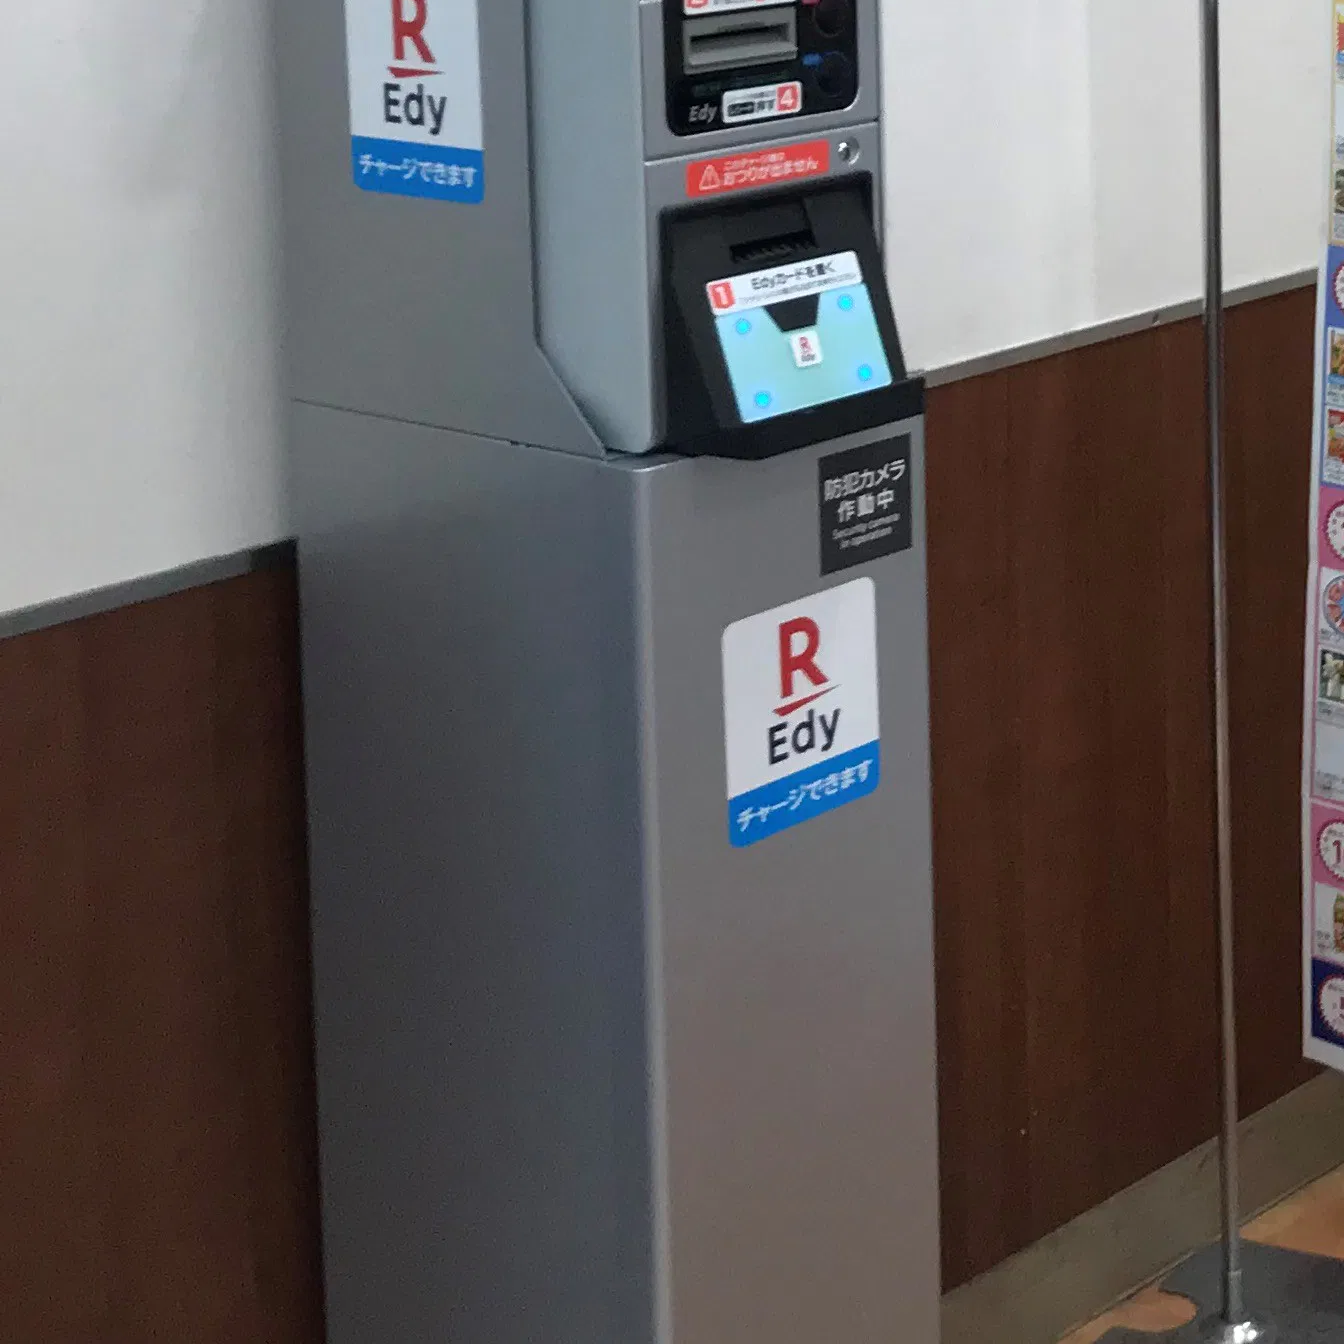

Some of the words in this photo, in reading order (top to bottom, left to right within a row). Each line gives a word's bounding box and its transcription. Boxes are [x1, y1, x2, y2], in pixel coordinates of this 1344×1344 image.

[382, 82, 448, 135] Edy
[688, 102, 718, 124] Edy
[779, 85, 794, 109] 4
[358, 153, 478, 189] チャージできます
[713, 285, 729, 308] 1
[822, 458, 906, 502] 防犯カメラ
[836, 488, 895, 524] 作動中
[777, 615, 830, 700] R
[767, 707, 842, 767] Edy
[736, 759, 874, 832] チャージできます
